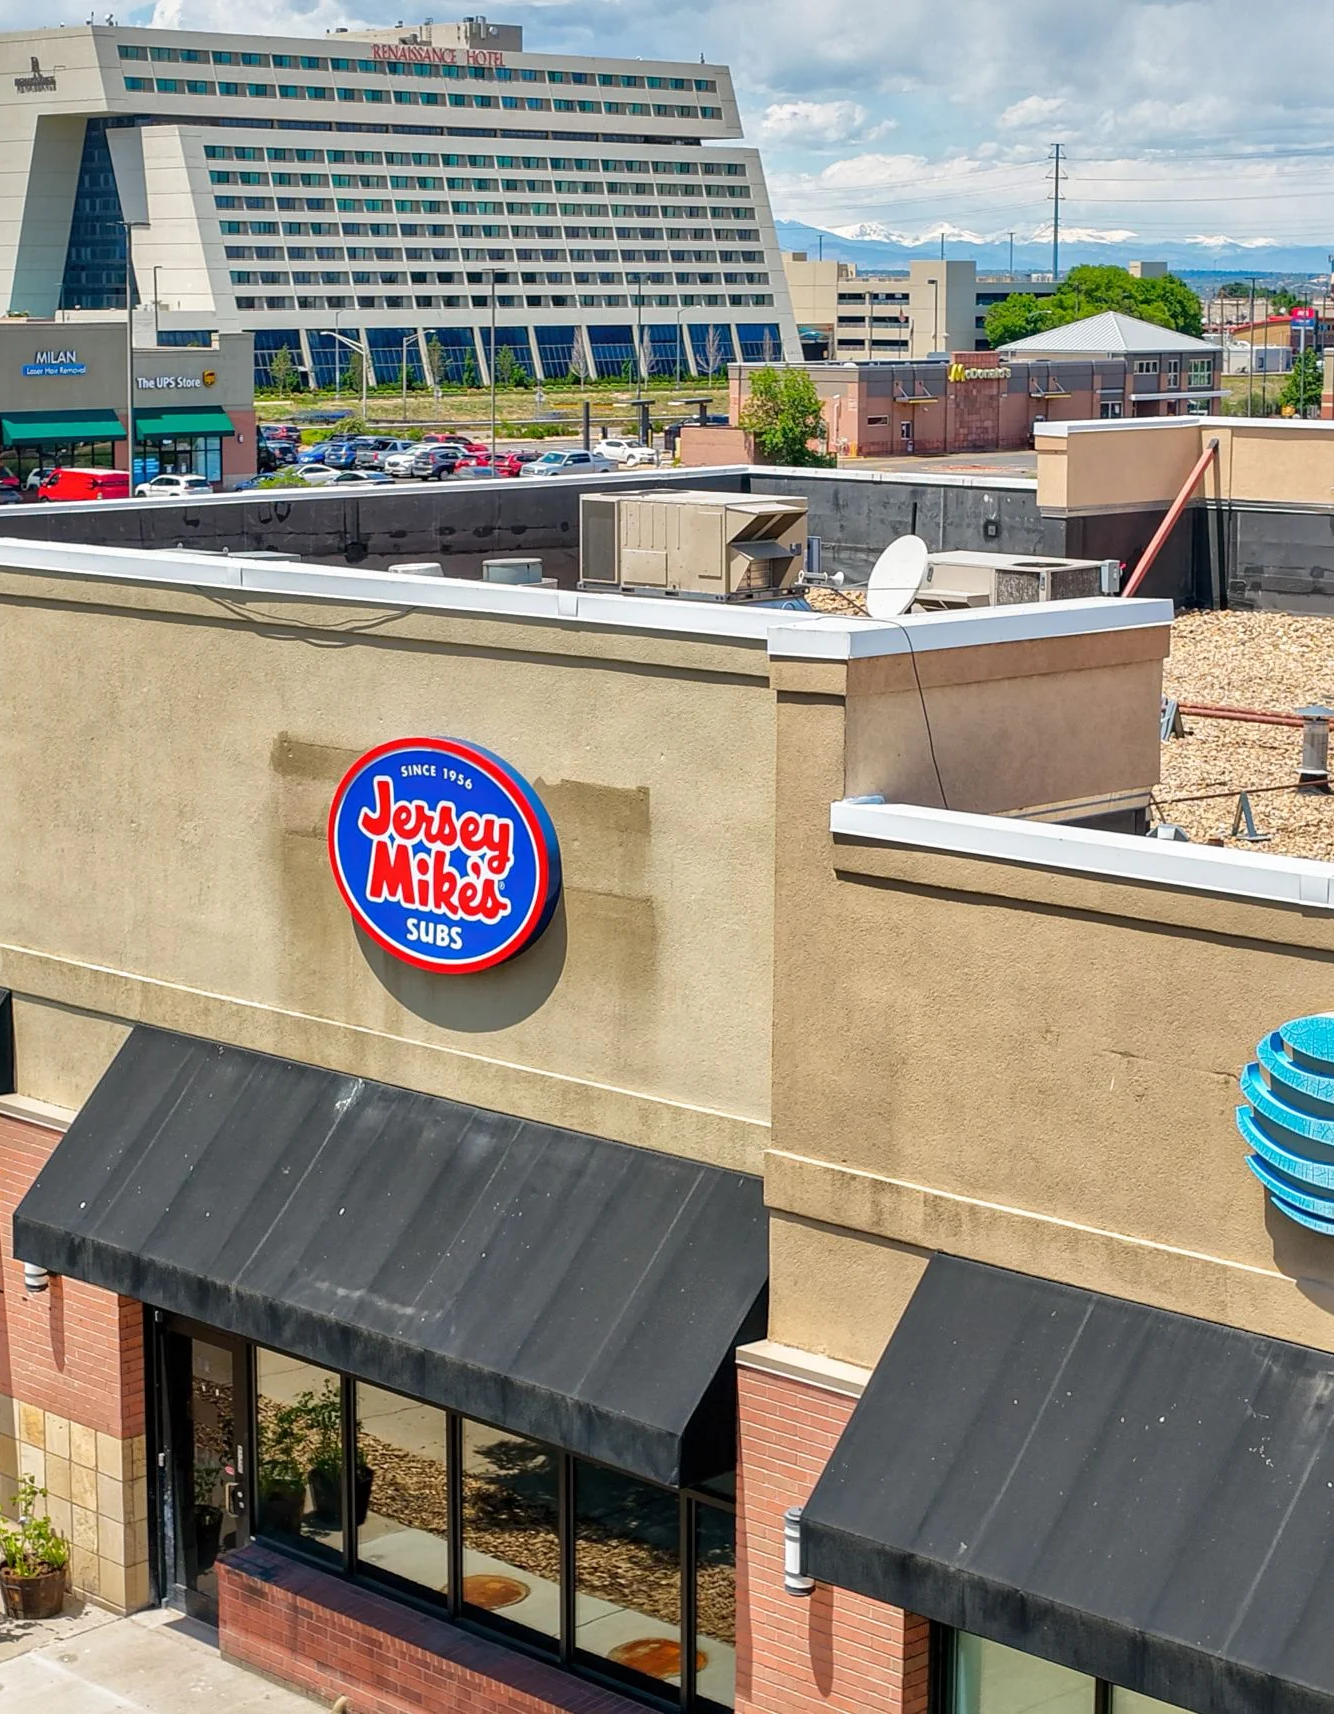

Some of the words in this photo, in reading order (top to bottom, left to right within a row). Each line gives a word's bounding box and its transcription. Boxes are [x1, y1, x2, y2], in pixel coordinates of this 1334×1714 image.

[371, 44, 457, 63] RENAISSANCE
[467, 50, 505, 67] HOTEL
[36, 351, 76, 364] MILAN
[137, 378, 154, 388] The
[156, 377, 175, 388] UPS
[177, 377, 201, 388] Store
[400, 764, 437, 778] SINCE
[443, 767, 473, 790] 1956
[360, 778, 512, 876] Jersey
[368, 840, 509, 921] Mike's
[407, 919, 463, 950] SUBS
